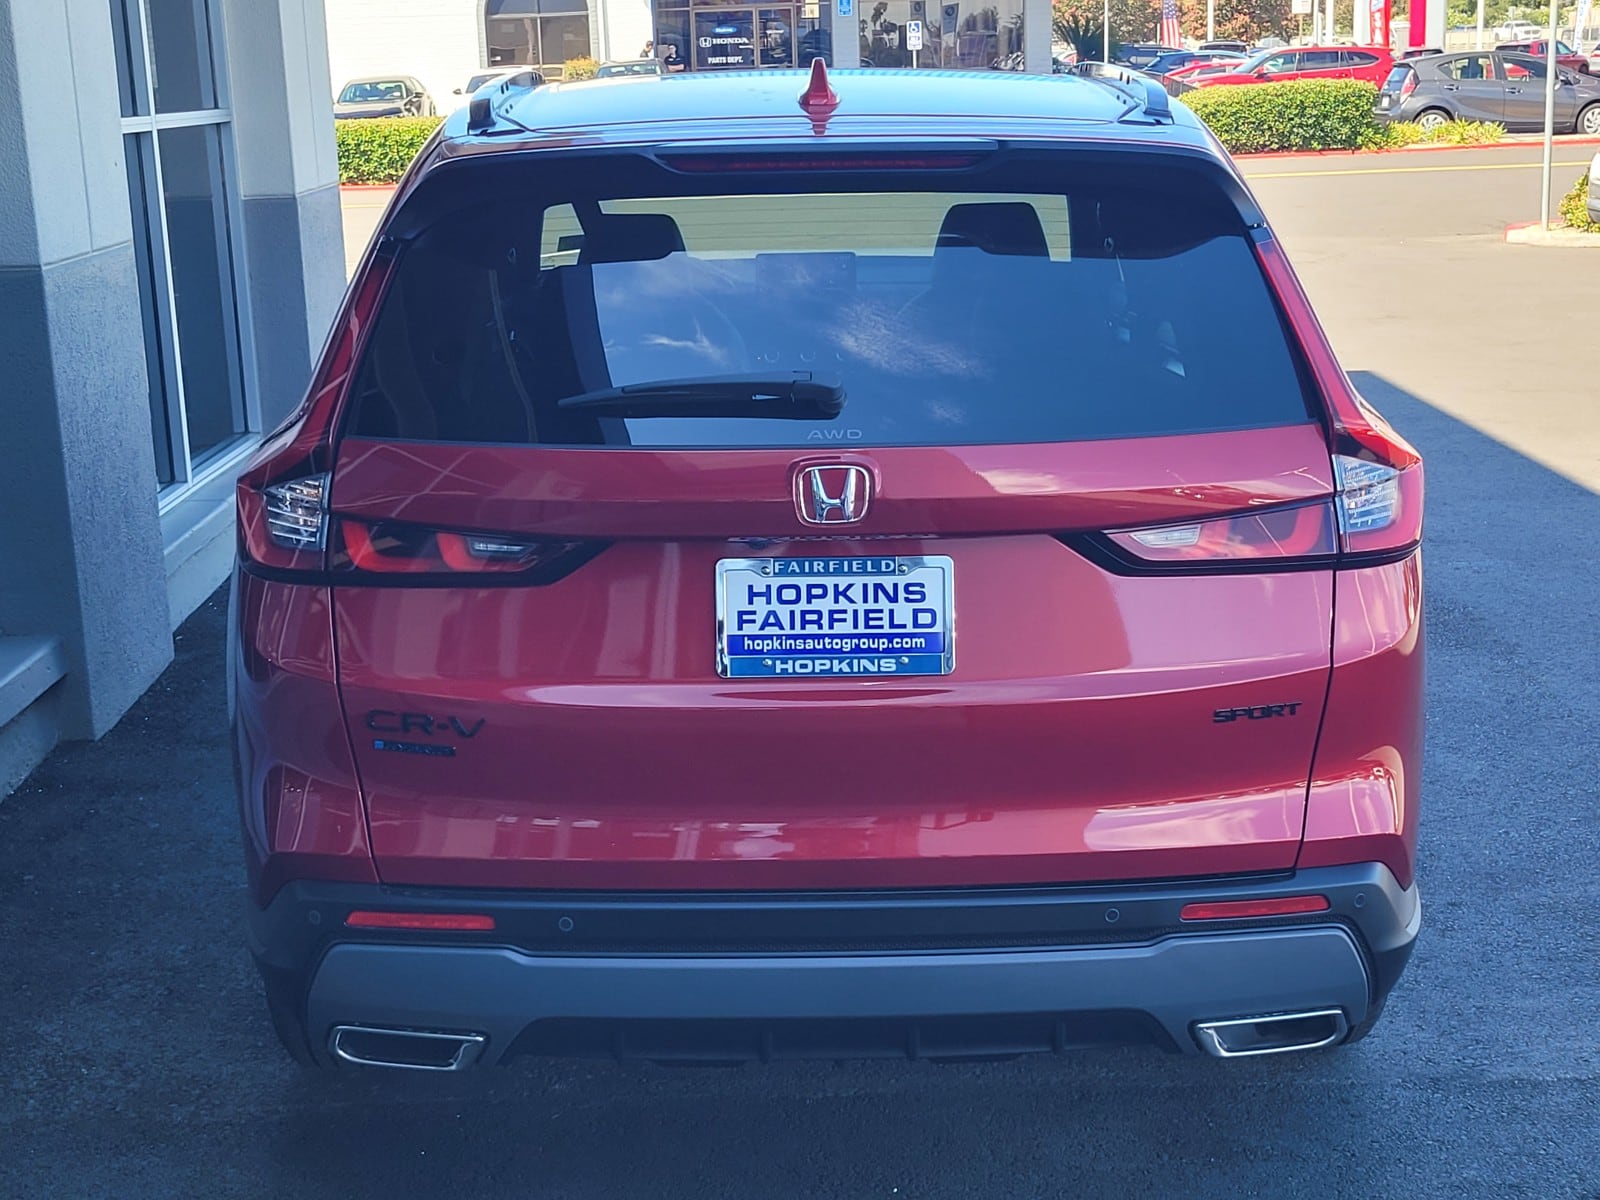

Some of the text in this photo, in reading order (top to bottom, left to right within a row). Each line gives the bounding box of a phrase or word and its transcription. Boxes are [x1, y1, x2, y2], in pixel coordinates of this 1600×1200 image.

[707, 56, 726, 64] PARTS
[807, 429, 862, 440] AWD
[774, 559, 895, 573] FAIRFIELD
[747, 582, 927, 606] HOPKINS
[736, 608, 938, 632] FAIRFIELD
[744, 636, 926, 653] hopkinsautogroup.com
[775, 658, 897, 674] HOPKINS
[1212, 701, 1303, 723] SPORT
[366, 709, 486, 738] CR-V
